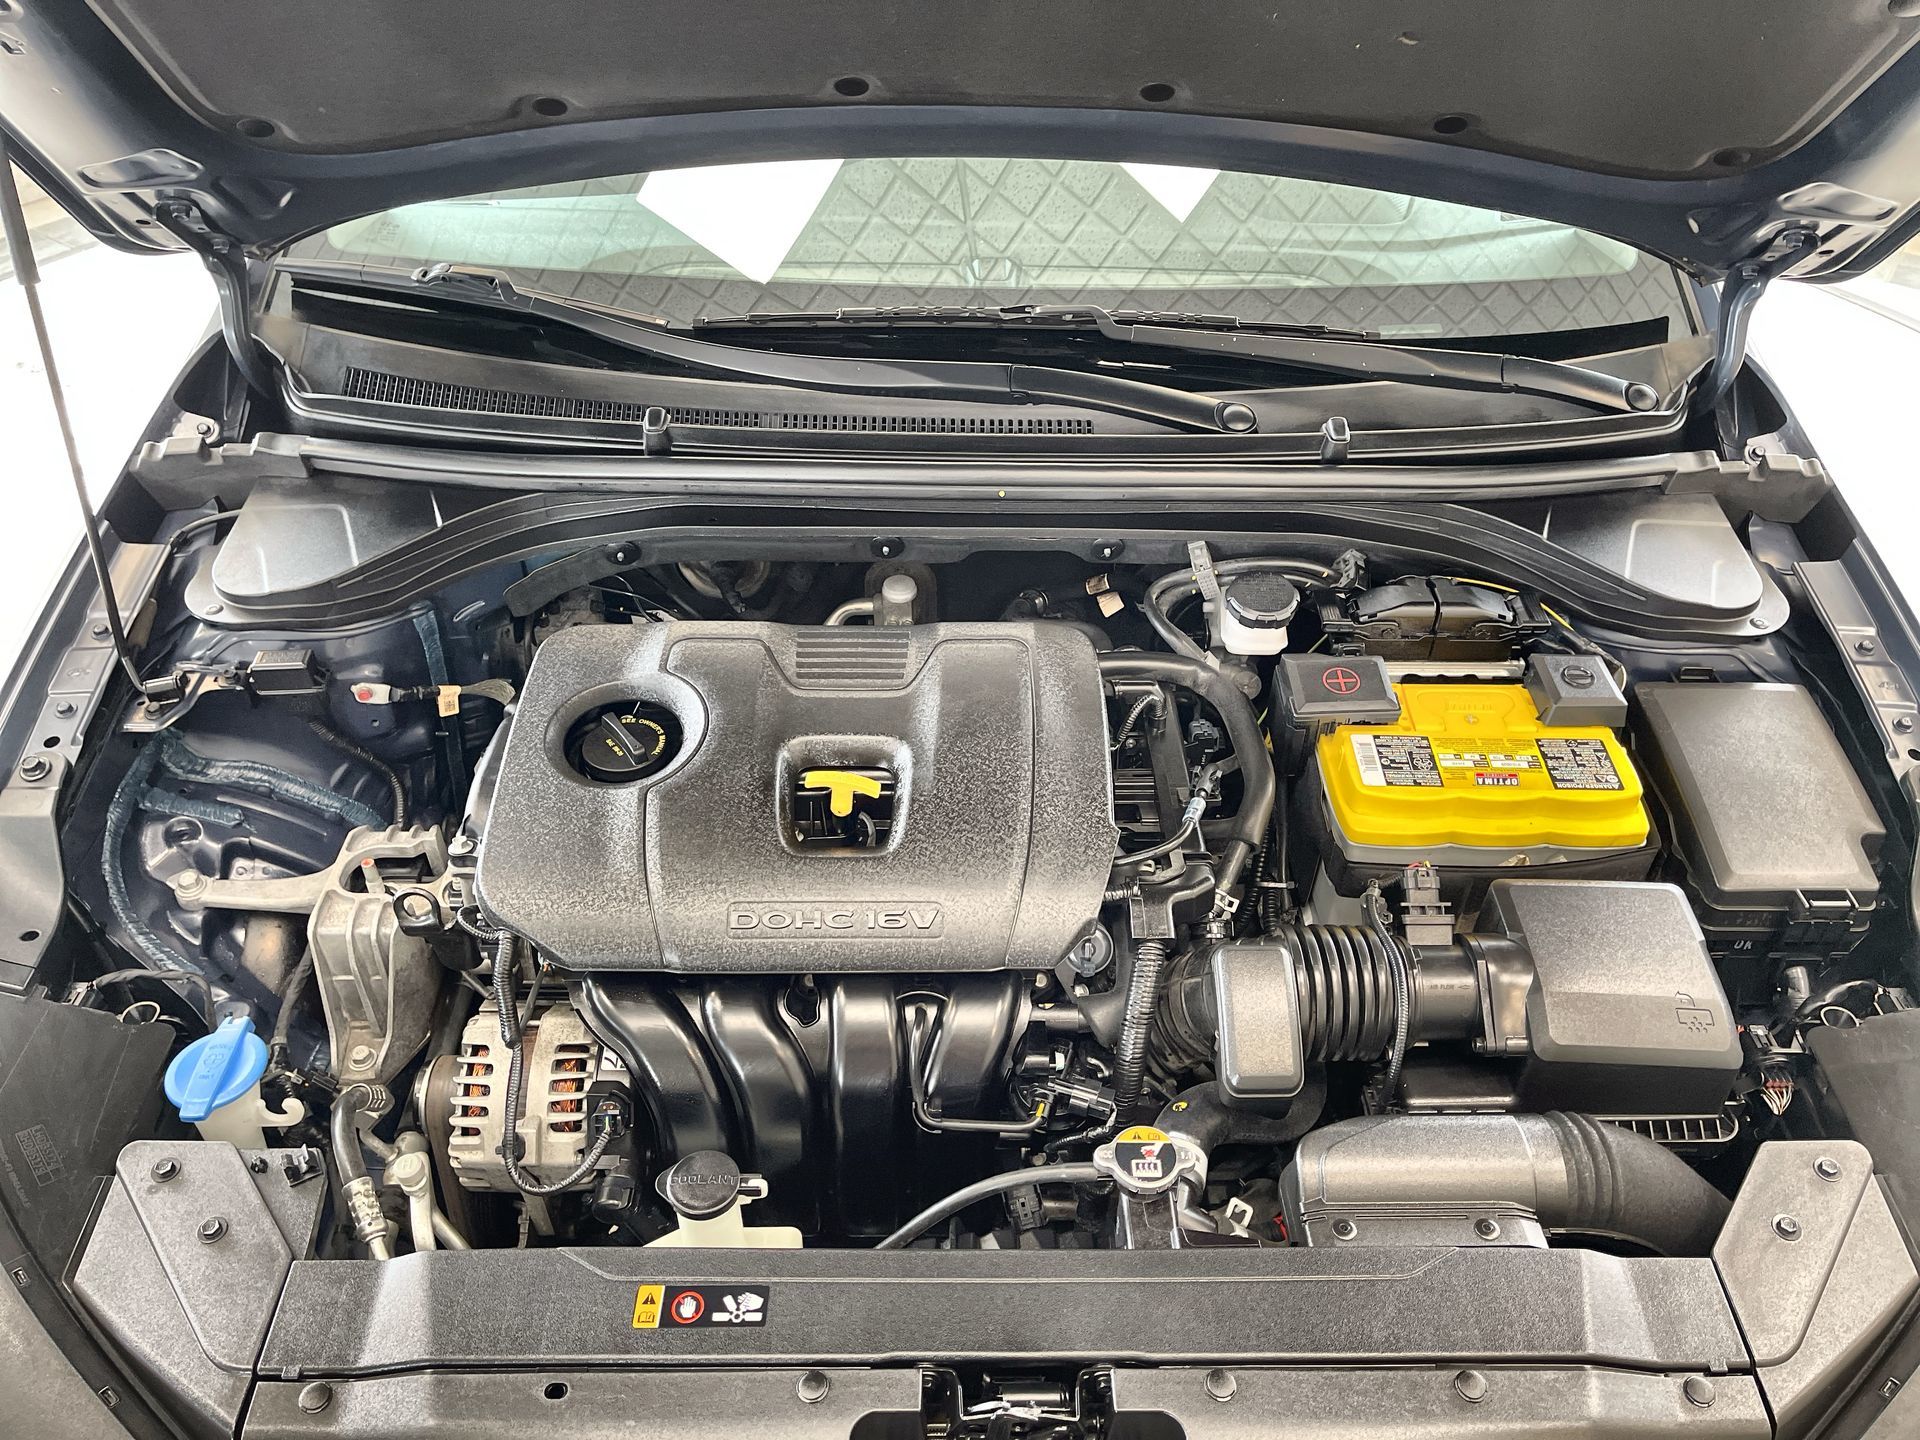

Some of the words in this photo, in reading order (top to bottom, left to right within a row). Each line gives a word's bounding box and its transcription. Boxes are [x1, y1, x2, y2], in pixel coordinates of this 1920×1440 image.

[639, 718, 664, 734] OWNER'S
[1477, 778, 1518, 786] OPTIMA
[730, 910, 855, 930] DOHC
[865, 909, 940, 930] 16V
[670, 1174, 738, 1186] COOLANT
